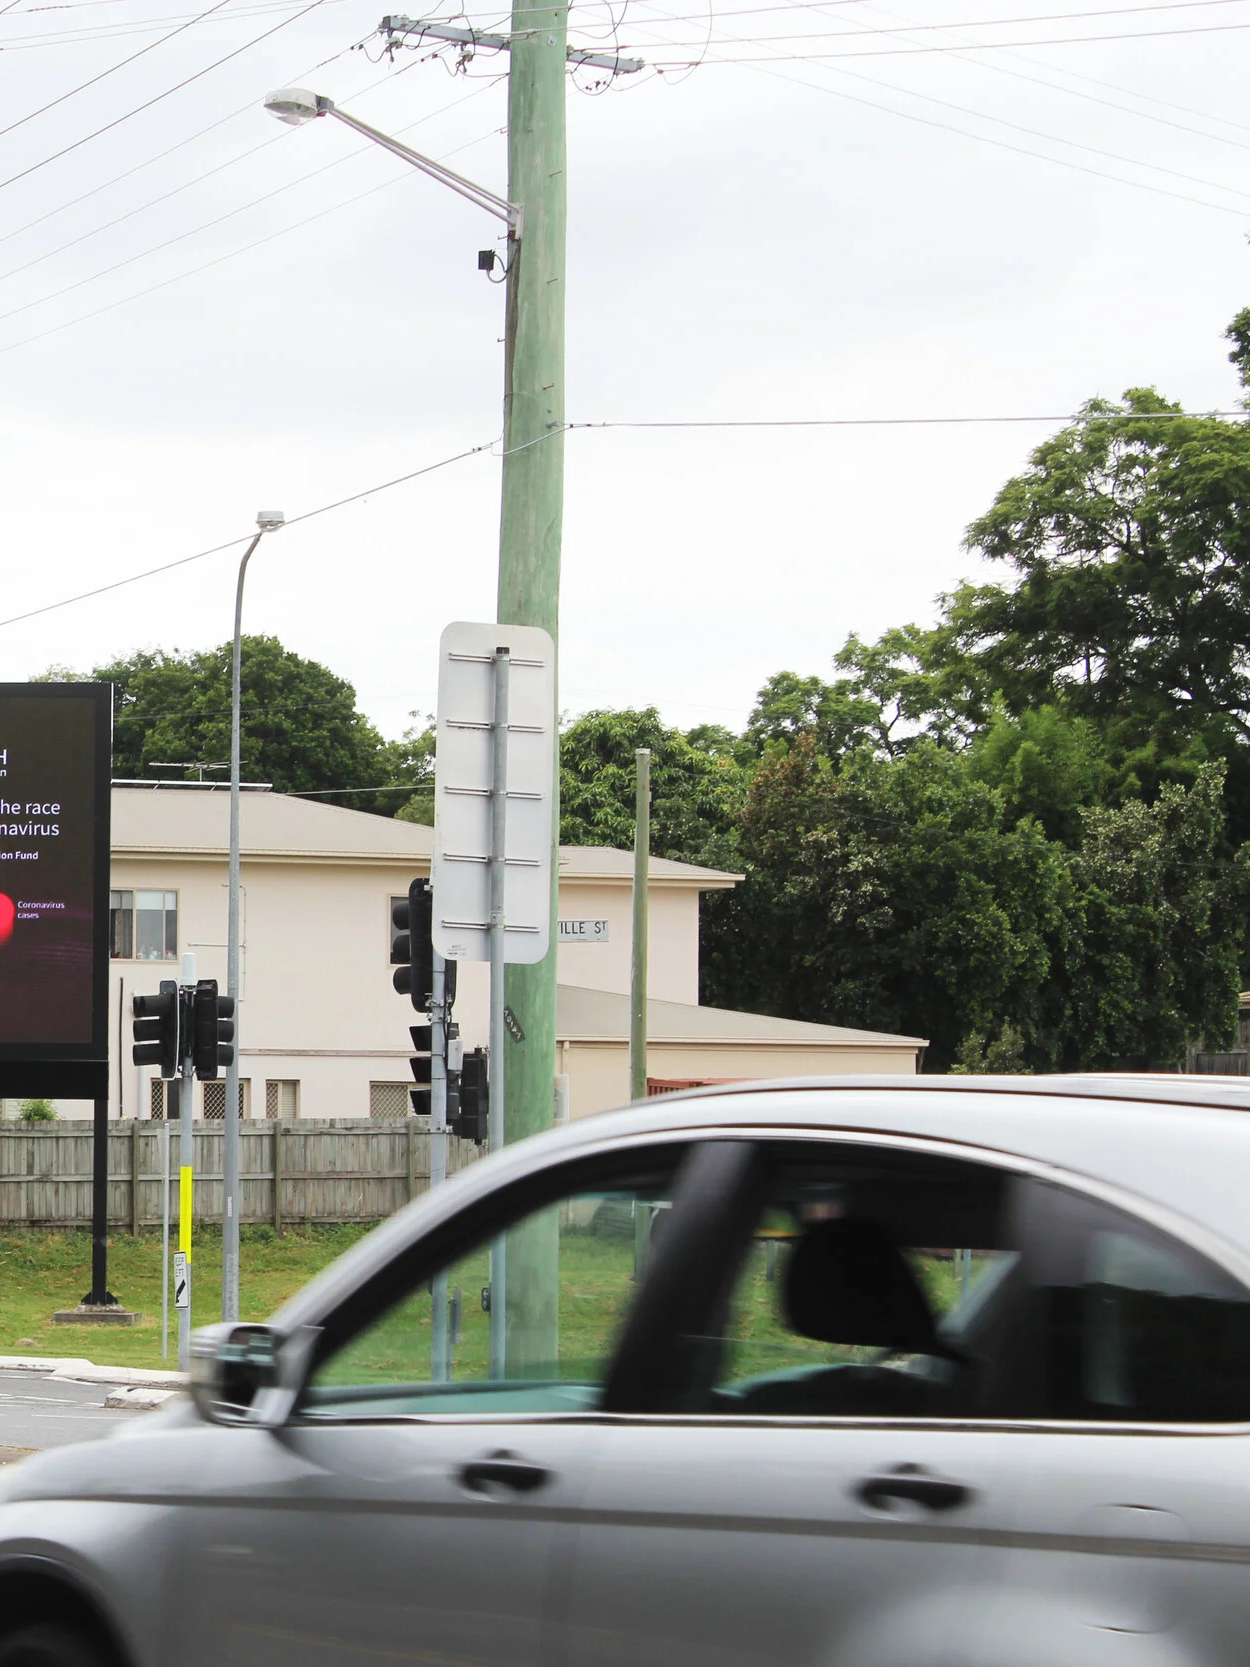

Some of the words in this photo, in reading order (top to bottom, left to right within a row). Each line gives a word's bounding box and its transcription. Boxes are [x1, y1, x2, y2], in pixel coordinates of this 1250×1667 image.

[25, 802, 61, 815] race
[15, 851, 39, 860] Fund
[17, 901, 65, 909] Coronavirus
